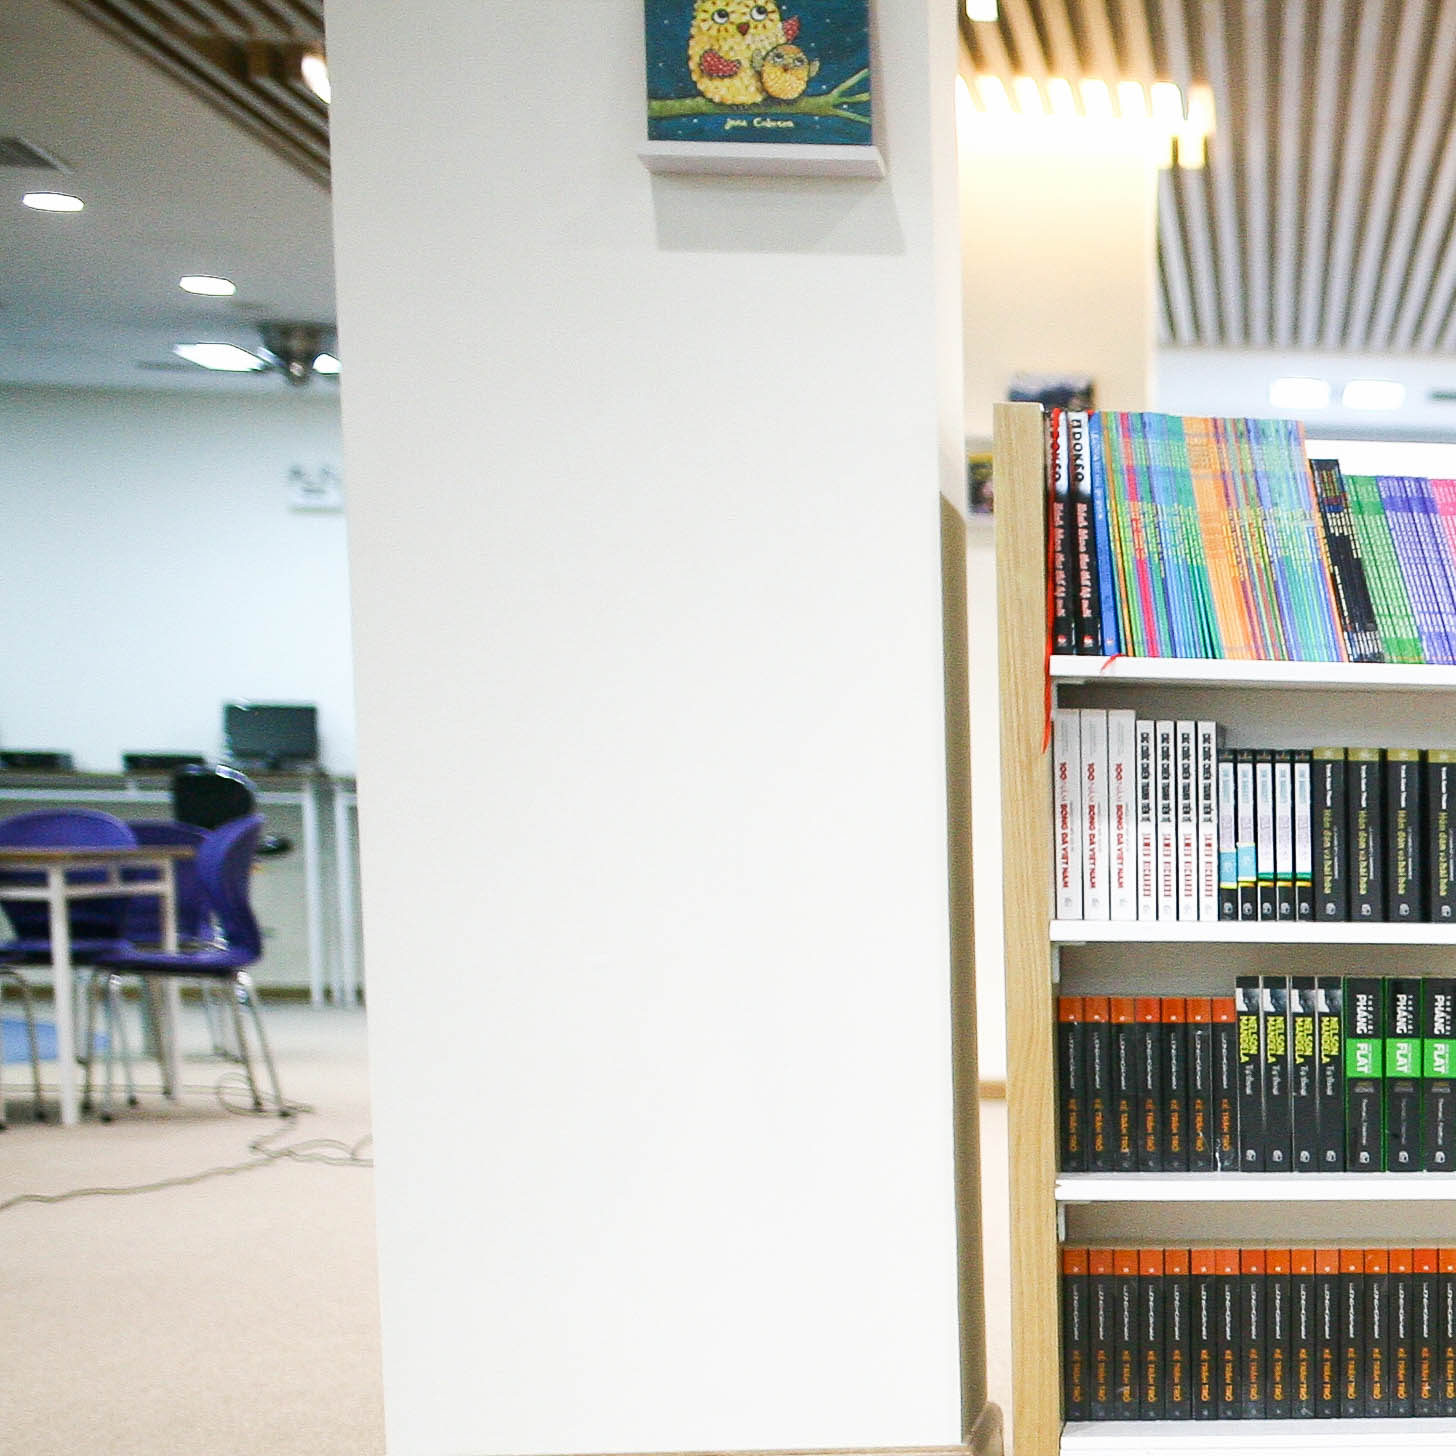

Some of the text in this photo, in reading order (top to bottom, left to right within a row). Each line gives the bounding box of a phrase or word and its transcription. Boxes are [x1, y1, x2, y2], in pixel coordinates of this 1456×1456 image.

[1249, 1016, 1258, 1054] NELSON
[1276, 1017, 1285, 1055] NELSON
[1304, 1017, 1313, 1055] NELSON
[1330, 1017, 1339, 1055] NELSON
[1356, 1043, 1369, 1073] FLAT
[1397, 1043, 1409, 1073] FLAT
[1434, 1043, 1446, 1073] FLAT
